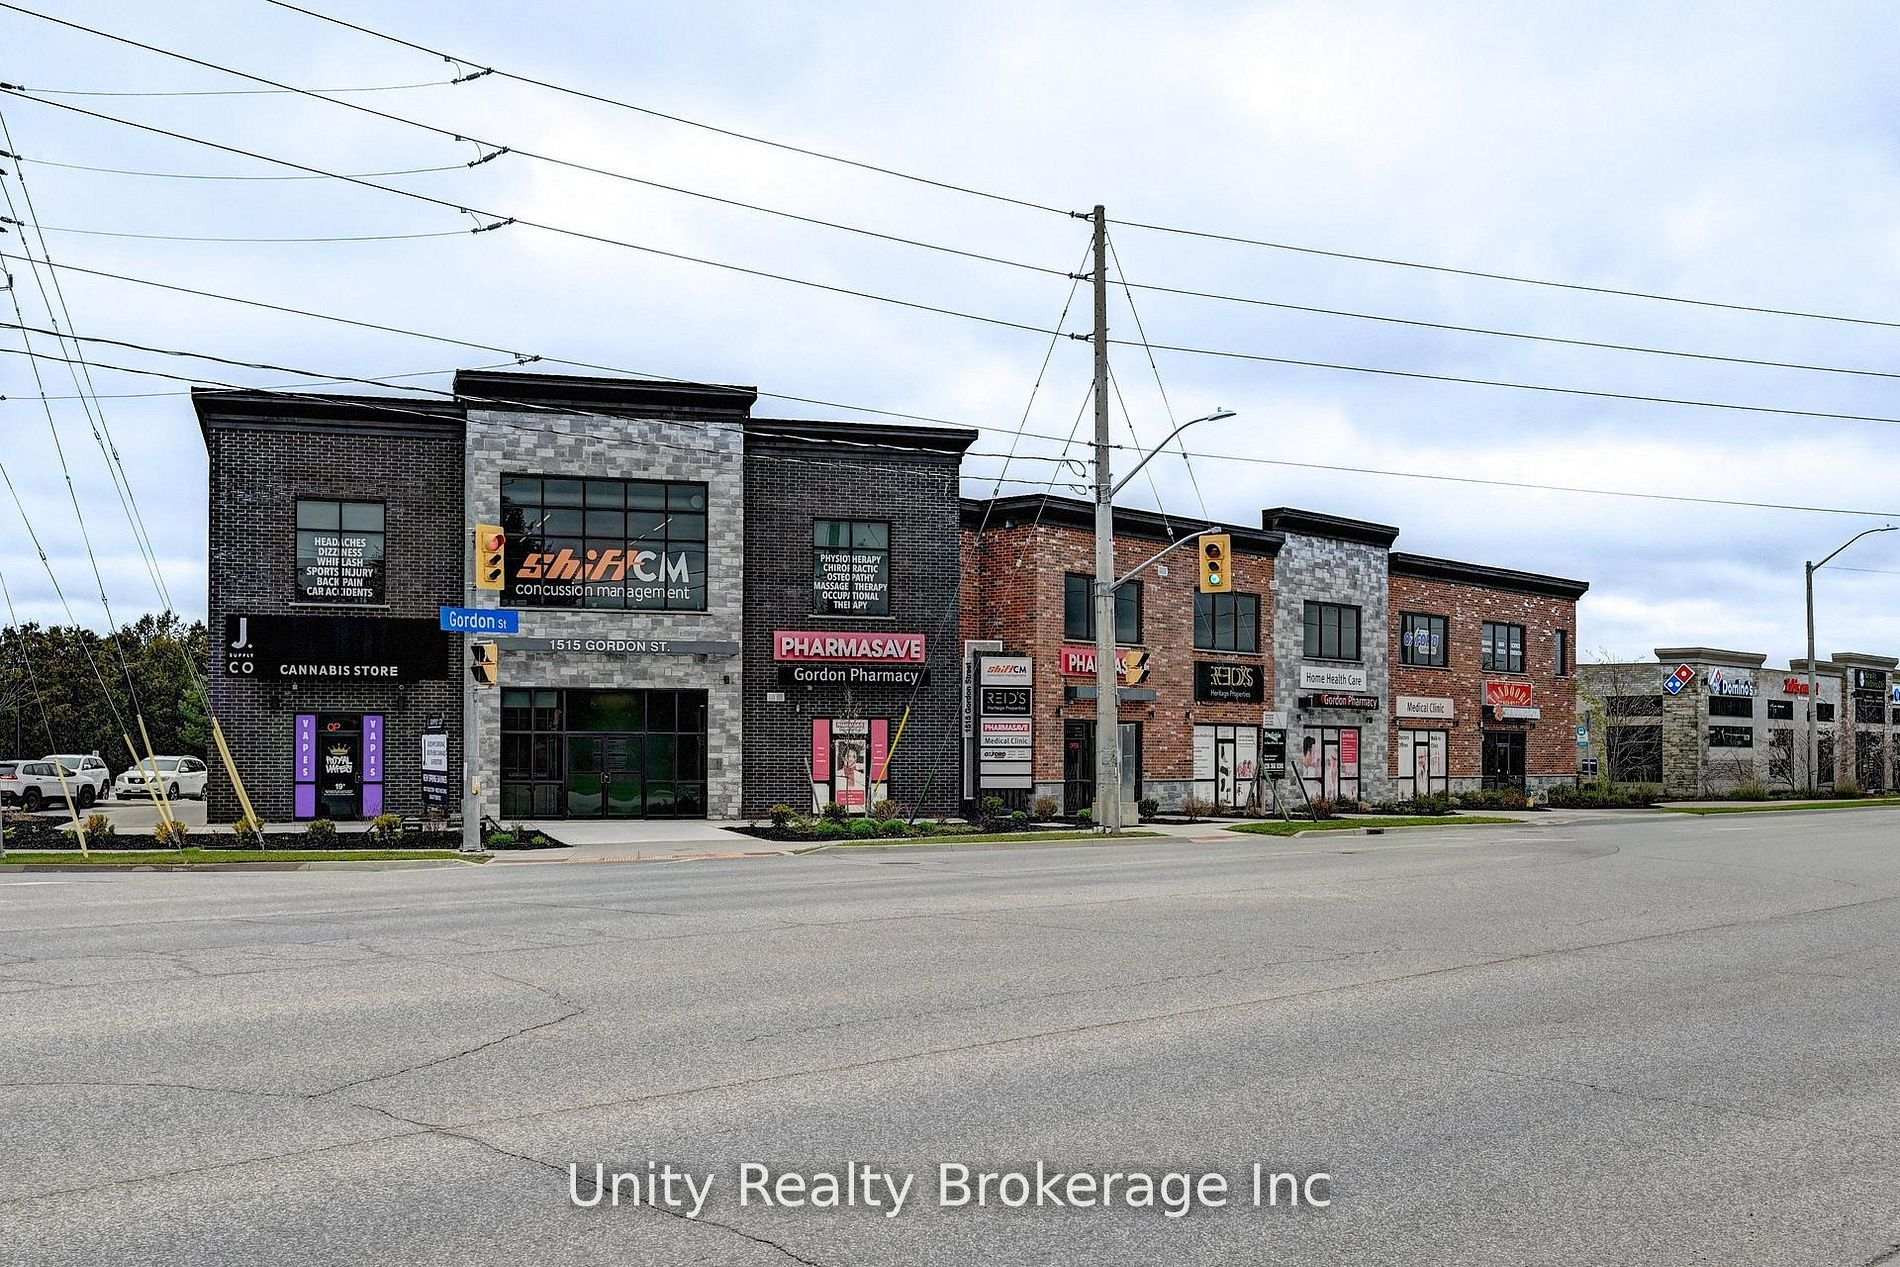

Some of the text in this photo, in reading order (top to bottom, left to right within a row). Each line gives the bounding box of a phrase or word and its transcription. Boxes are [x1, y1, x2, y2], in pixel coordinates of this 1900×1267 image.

[314, 537, 367, 548] HEADACHES
[318, 547, 363, 557] DIZZINESS
[317, 557, 364, 567] WHIPLASH
[820, 554, 882, 564] PHYSIOTHERAPY
[306, 567, 374, 577] SPORTS INJURY
[823, 563, 879, 573] CHIROPRACTIC
[317, 577, 363, 587] BACK PAIN
[827, 572, 875, 582] OSTEOPATHY
[306, 586, 373, 597] CAR ACCIDENTS
[515, 582, 690, 602] concussion management
[814, 581, 888, 592] MASSAGE THERAPY
[449, 611, 495, 629] Gordon
[550, 640, 670, 652] 1515 GORDON ST.
[781, 637, 921, 658] PHARMASAVE
[229, 661, 254, 674] CO
[280, 664, 399, 677] CANNABIS STORE
[794, 667, 919, 686] Gordon Pharmacy
[1306, 672, 1362, 686] Home Health Care
[1722, 679, 1754, 696] Domino's
[1323, 694, 1378, 708] Gordon Pharmacy
[1407, 701, 1445, 714] Medical Clinic
[985, 737, 1028, 745] Medical Clinic
